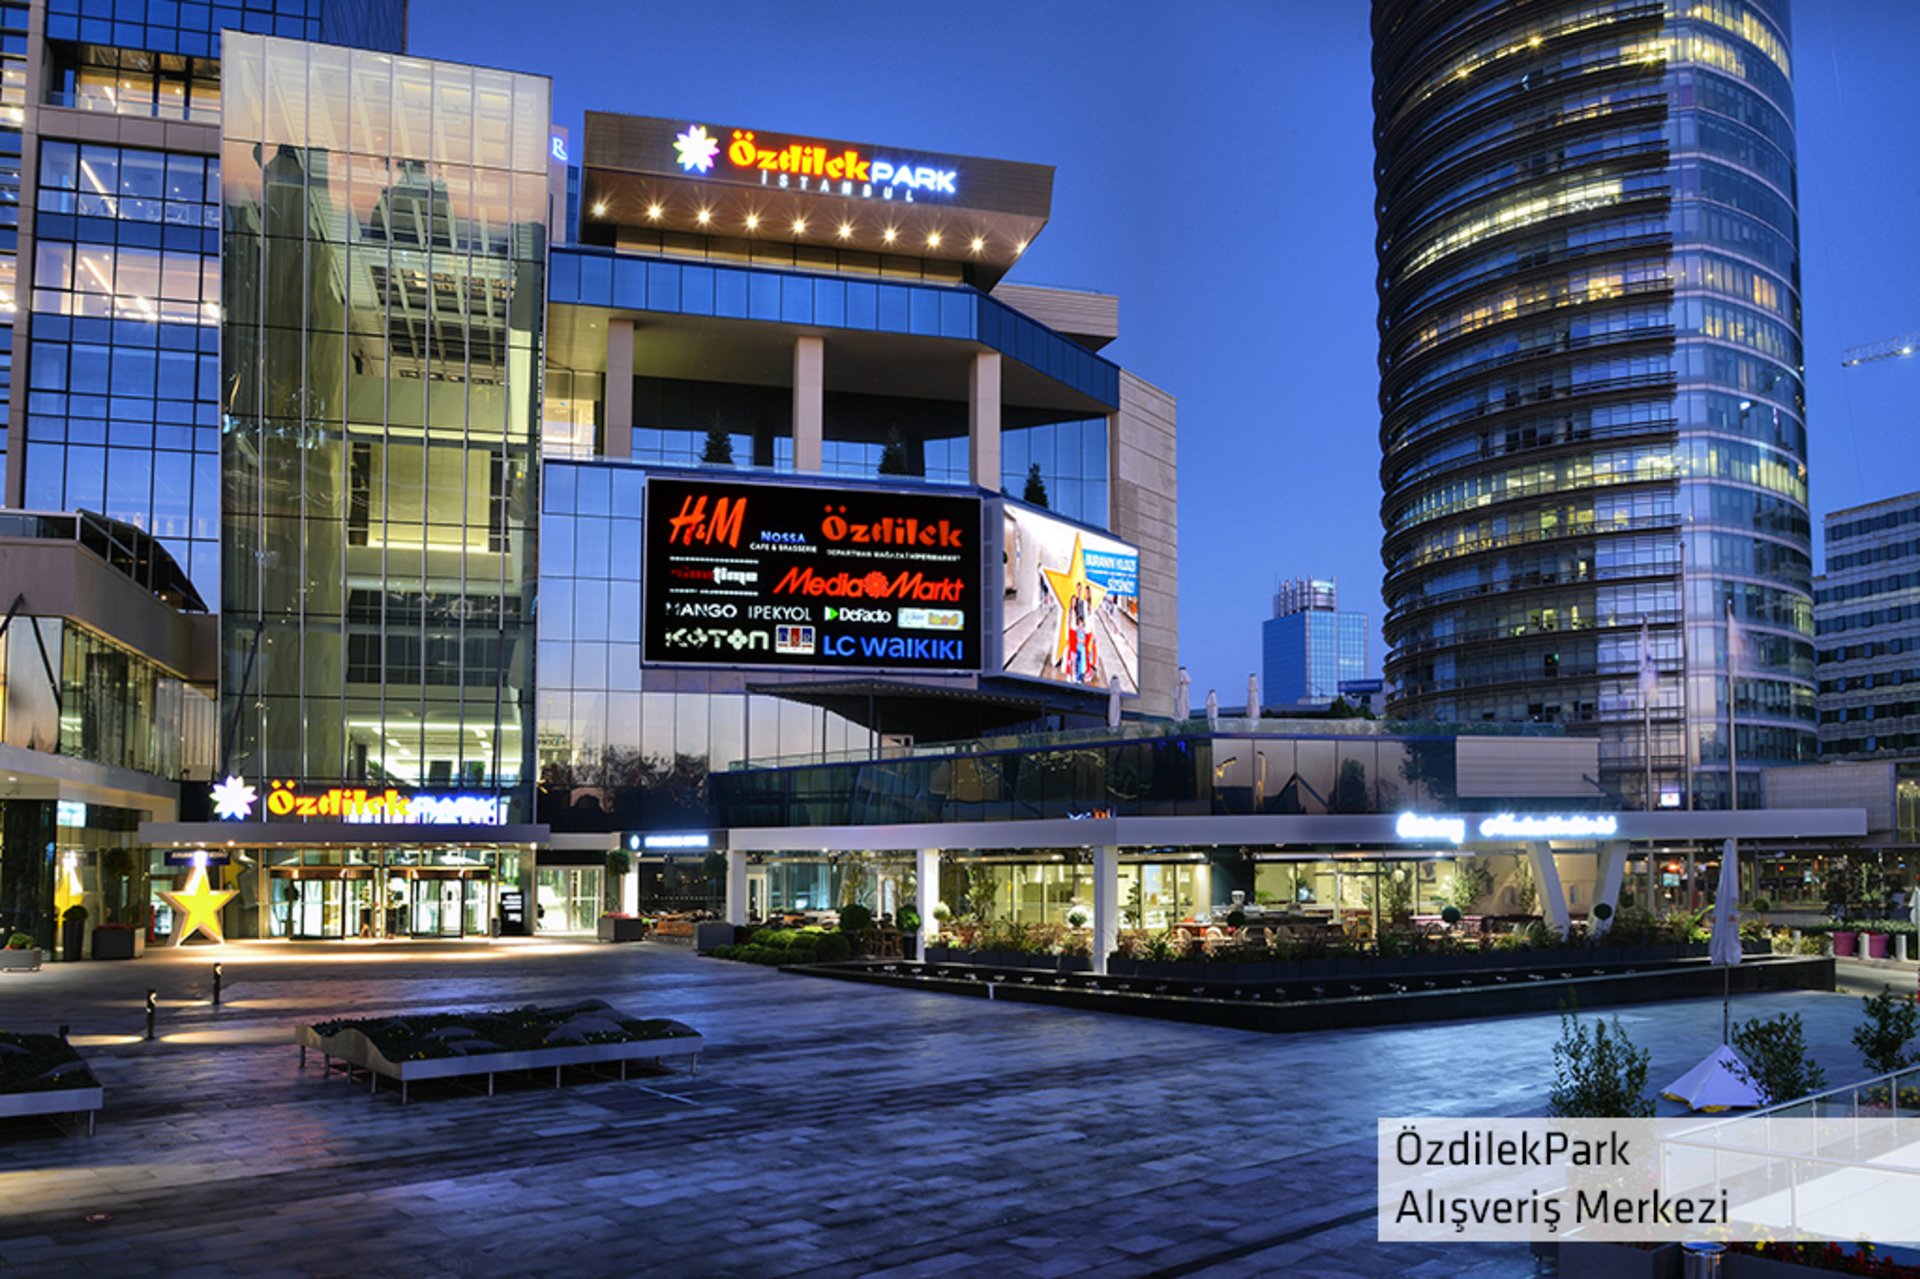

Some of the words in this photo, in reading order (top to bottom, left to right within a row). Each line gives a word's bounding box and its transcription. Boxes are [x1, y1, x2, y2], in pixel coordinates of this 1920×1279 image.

[669, 495, 747, 549] H&M
[821, 504, 963, 548] Özdilek
[761, 531, 807, 544] NOSSA
[665, 602, 738, 618] MANGO
[839, 607, 892, 623] DeFacto
[823, 635, 856, 656] LC
